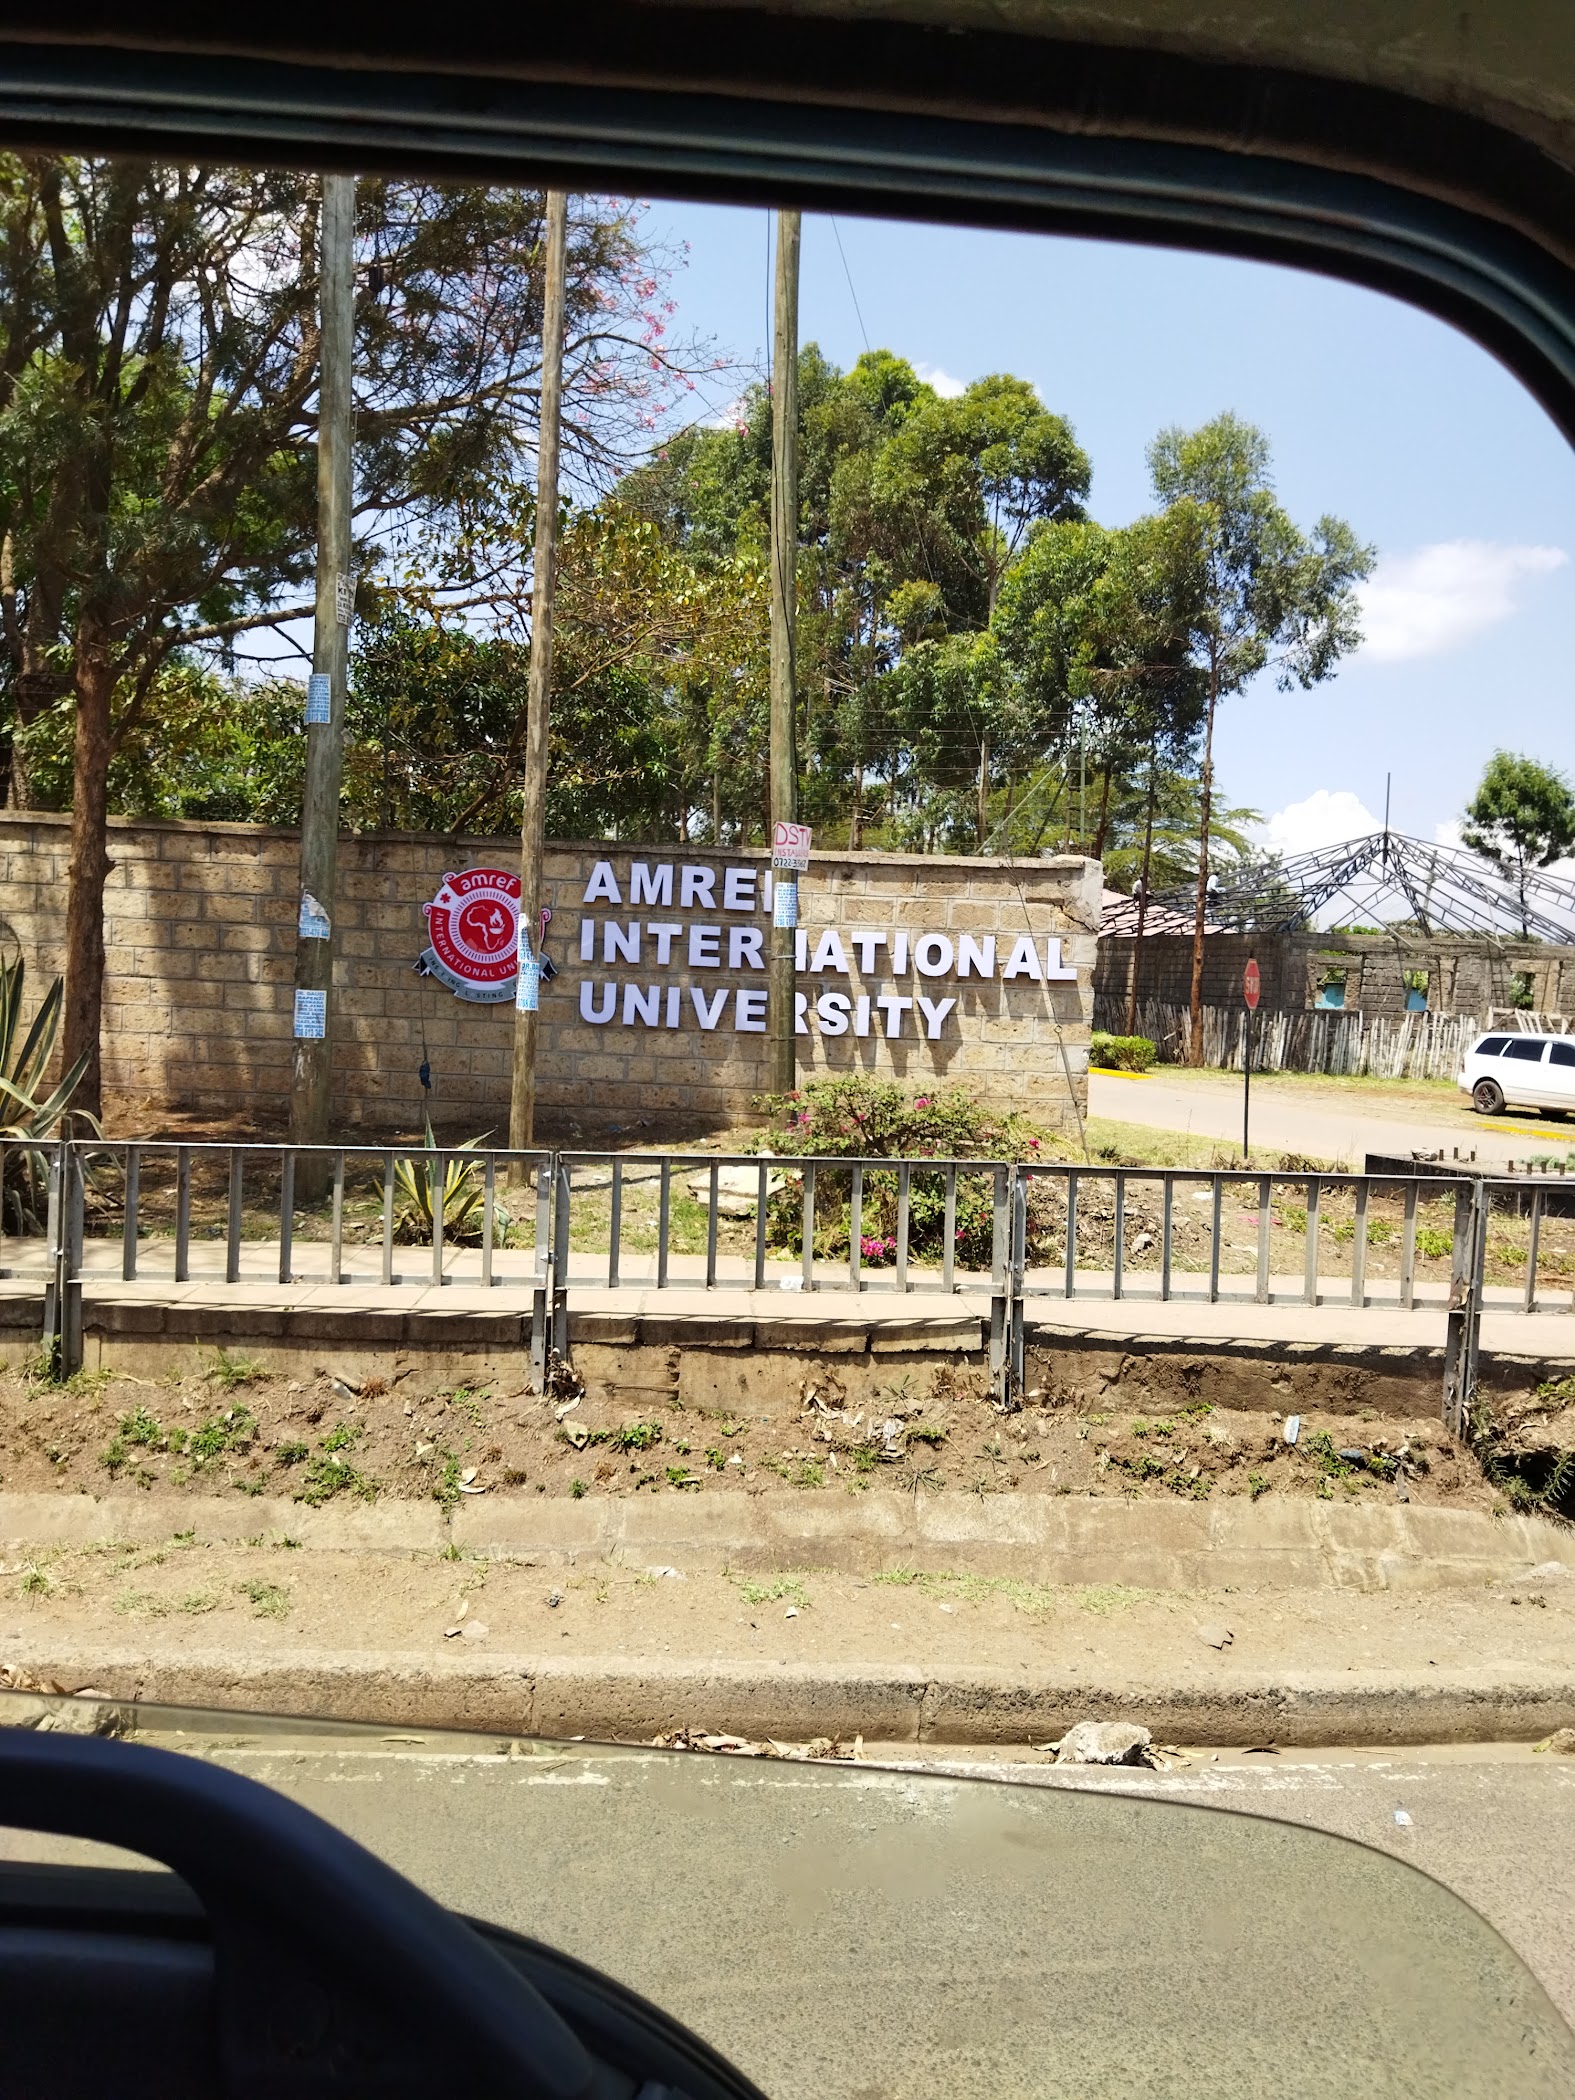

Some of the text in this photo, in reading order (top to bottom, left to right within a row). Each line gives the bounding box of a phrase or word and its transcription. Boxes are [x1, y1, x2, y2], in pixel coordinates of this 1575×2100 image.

[776, 823, 811, 847] DSTV
[460, 873, 517, 891] amref
[434, 911, 495, 977] INTERNATIONAL
